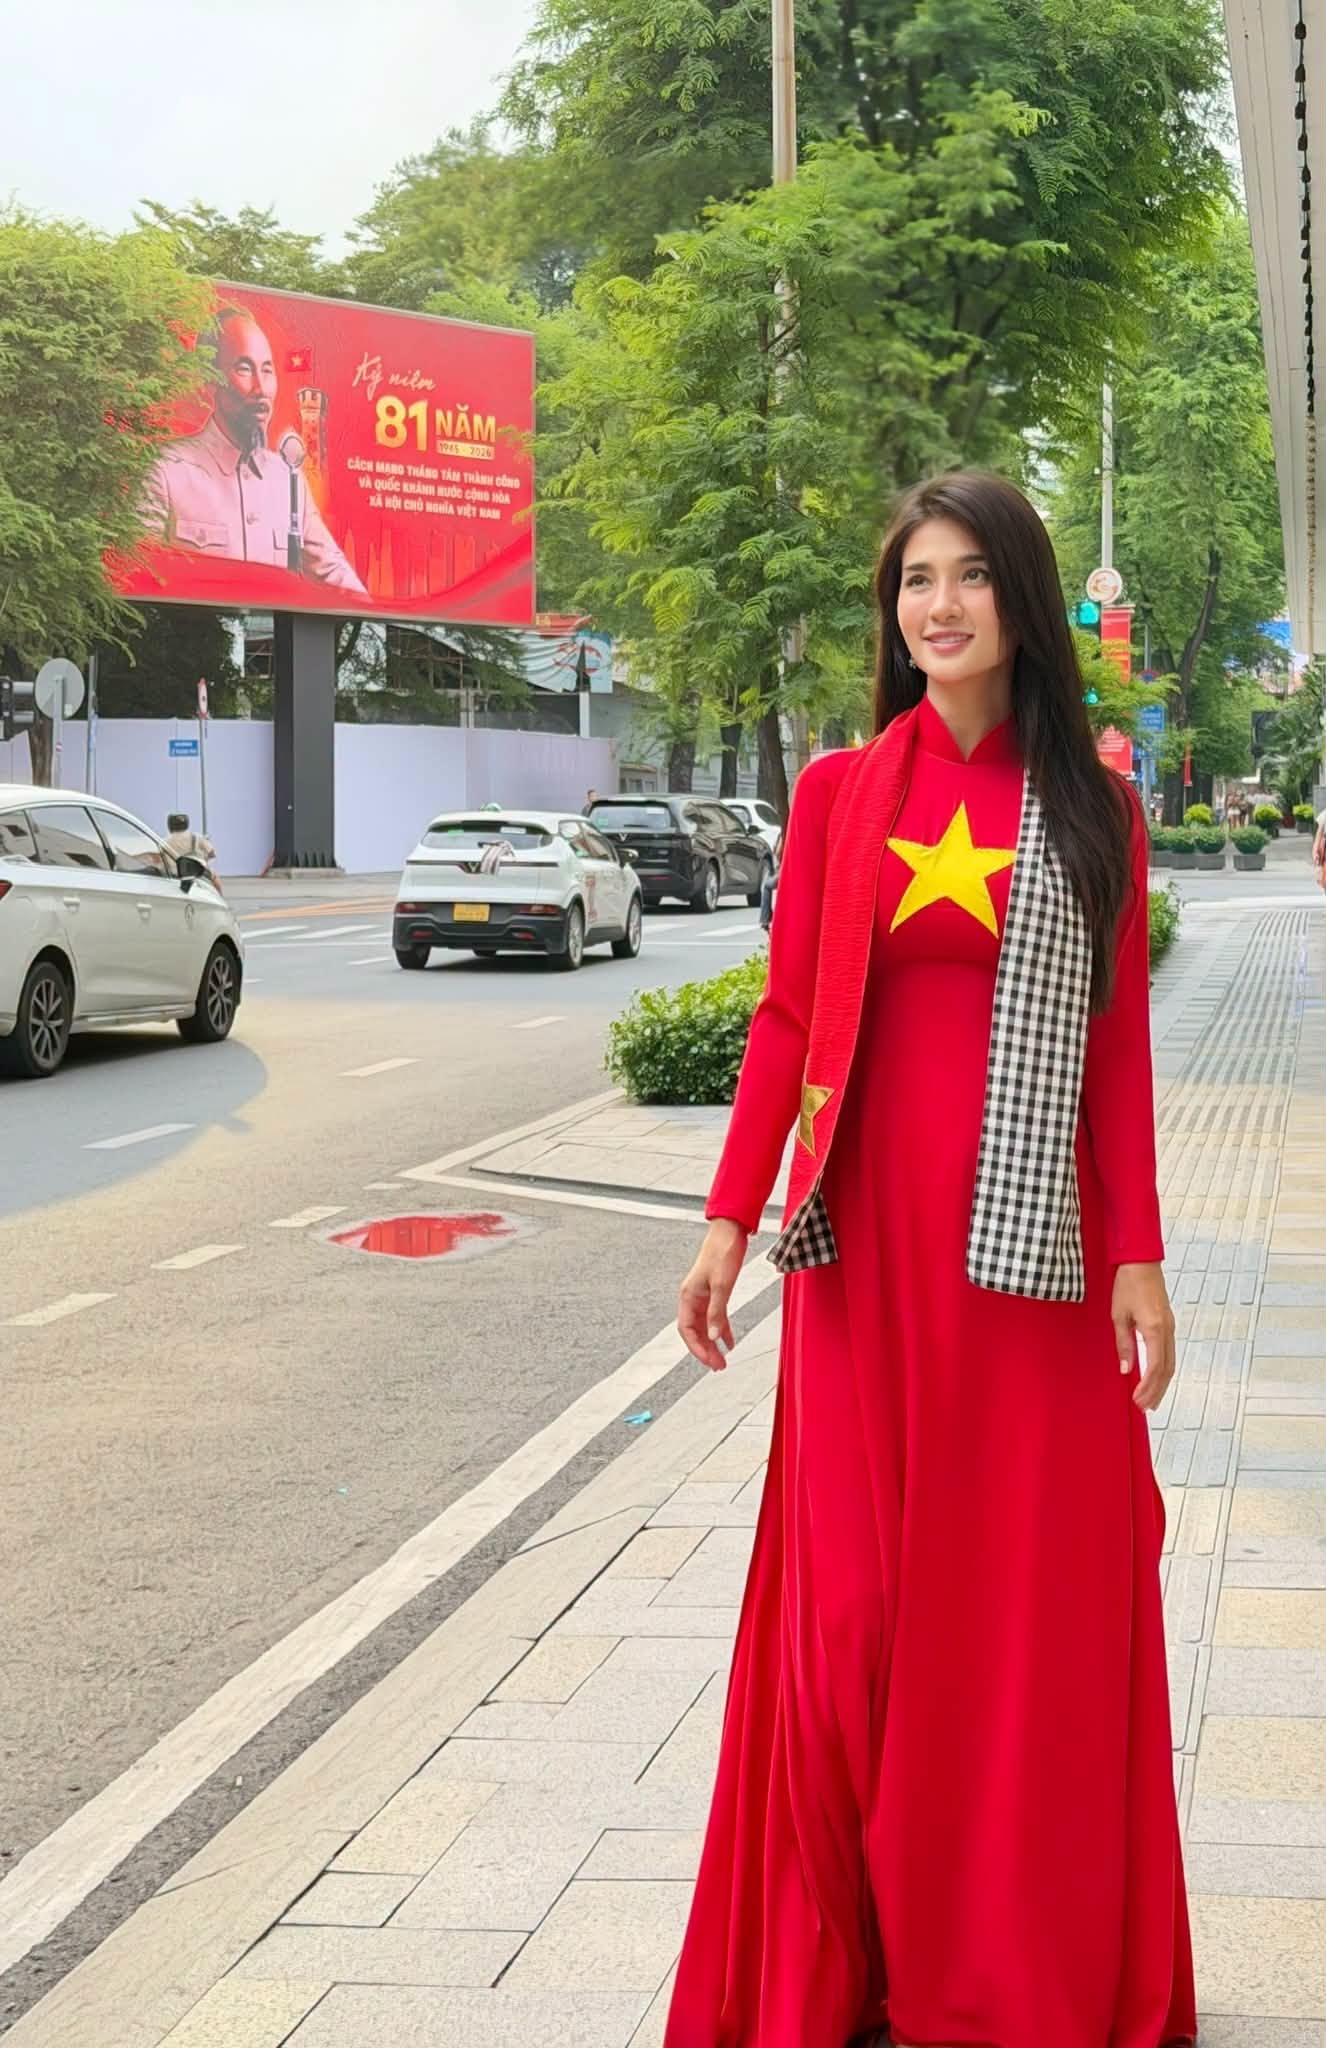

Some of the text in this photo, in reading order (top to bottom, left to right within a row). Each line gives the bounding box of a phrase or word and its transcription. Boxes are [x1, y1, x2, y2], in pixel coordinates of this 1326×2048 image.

[352, 352, 436, 400] Kỷ niệm
[376, 395, 496, 452] 81 NĂM
[440, 443, 459, 454] 1945
[470, 446, 491, 457] 2026
[347, 456, 374, 472] CÁCH
[407, 464, 438, 480] THÁNG
[440, 467, 461, 482] TÁM
[463, 470, 494, 486] THÀNH
[495, 474, 520, 489] CÔNG
[358, 475, 511, 504] VÀ QUỐC KHÁNH NƯỚC CỘNG HÒA
[369, 493, 501, 520] XÃ HỘI CHỦ NGHĨA VIỆT NAM
